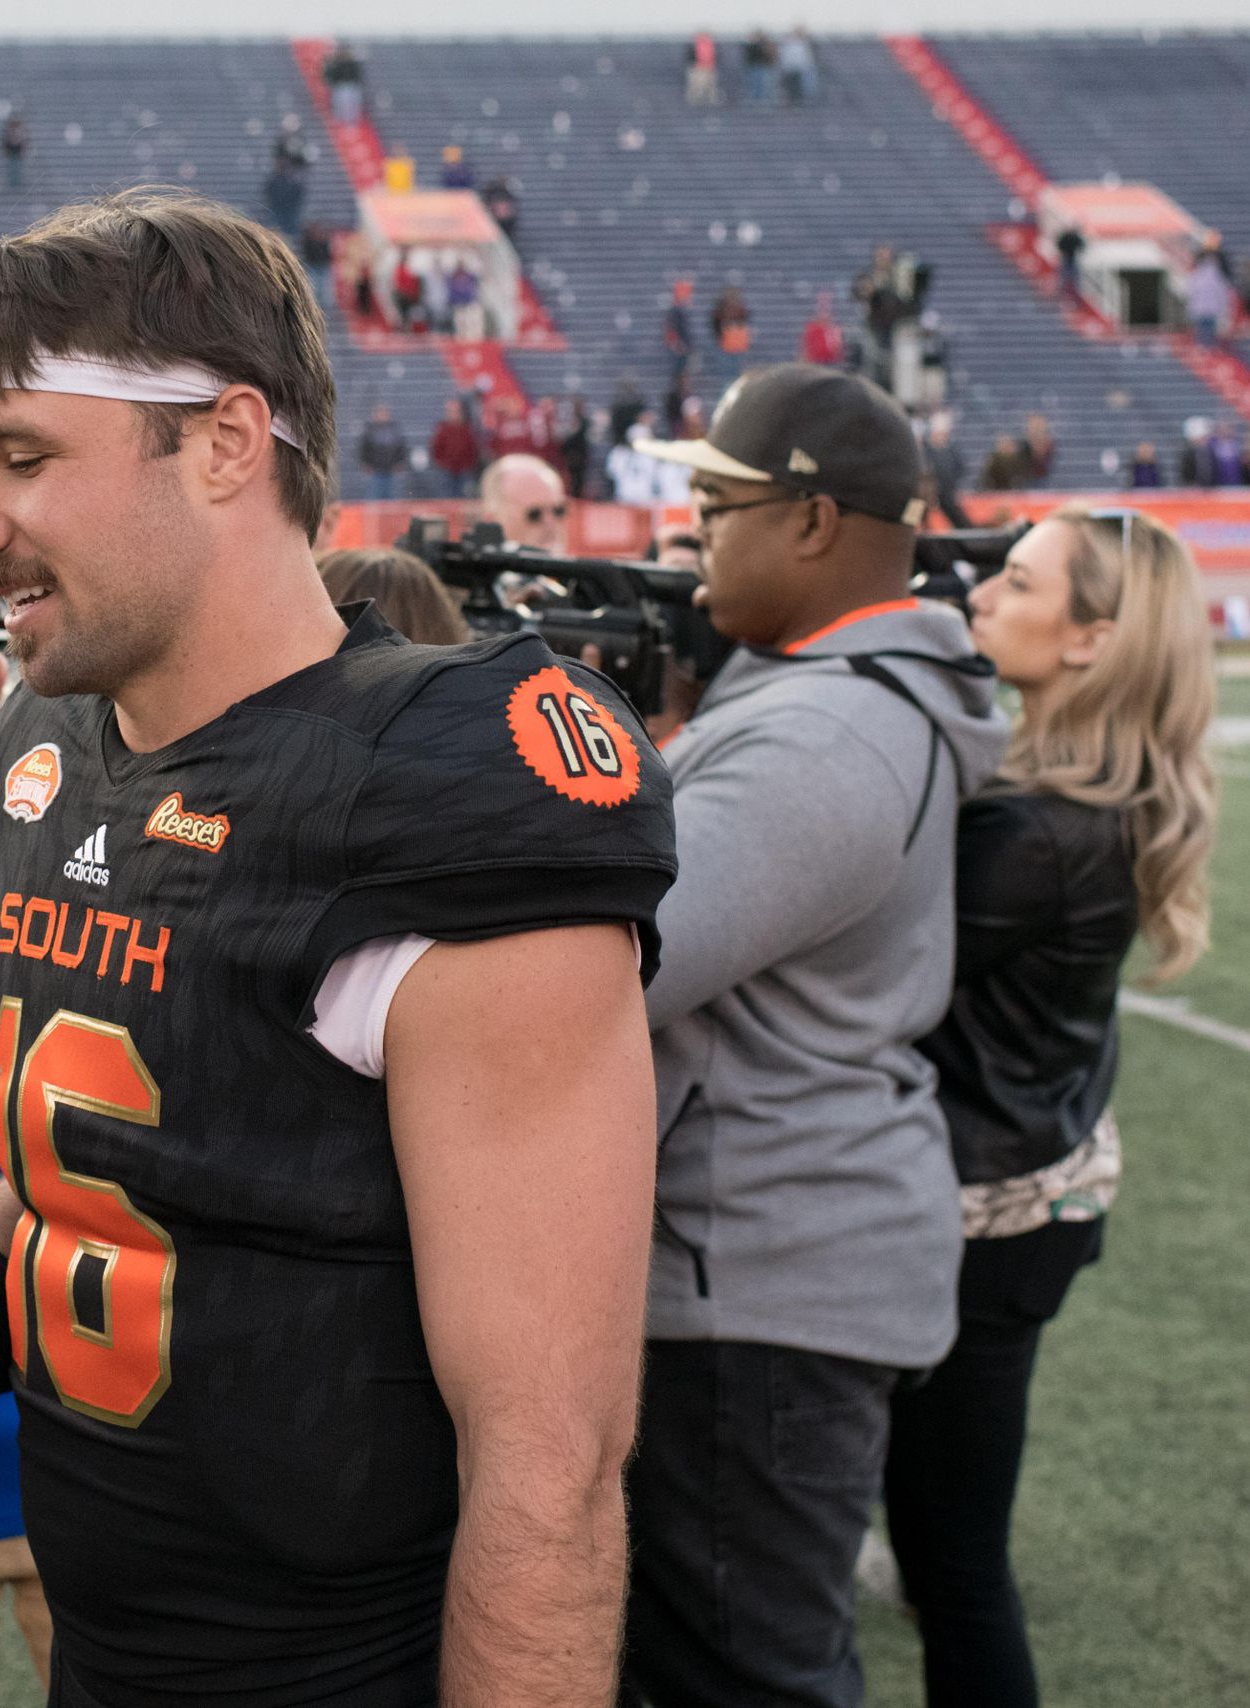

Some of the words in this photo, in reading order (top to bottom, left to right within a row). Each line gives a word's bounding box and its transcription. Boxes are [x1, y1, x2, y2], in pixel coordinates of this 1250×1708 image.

[536, 692, 623, 779] 16
[146, 796, 225, 847] Reese's
[63, 858, 111, 887] adidas
